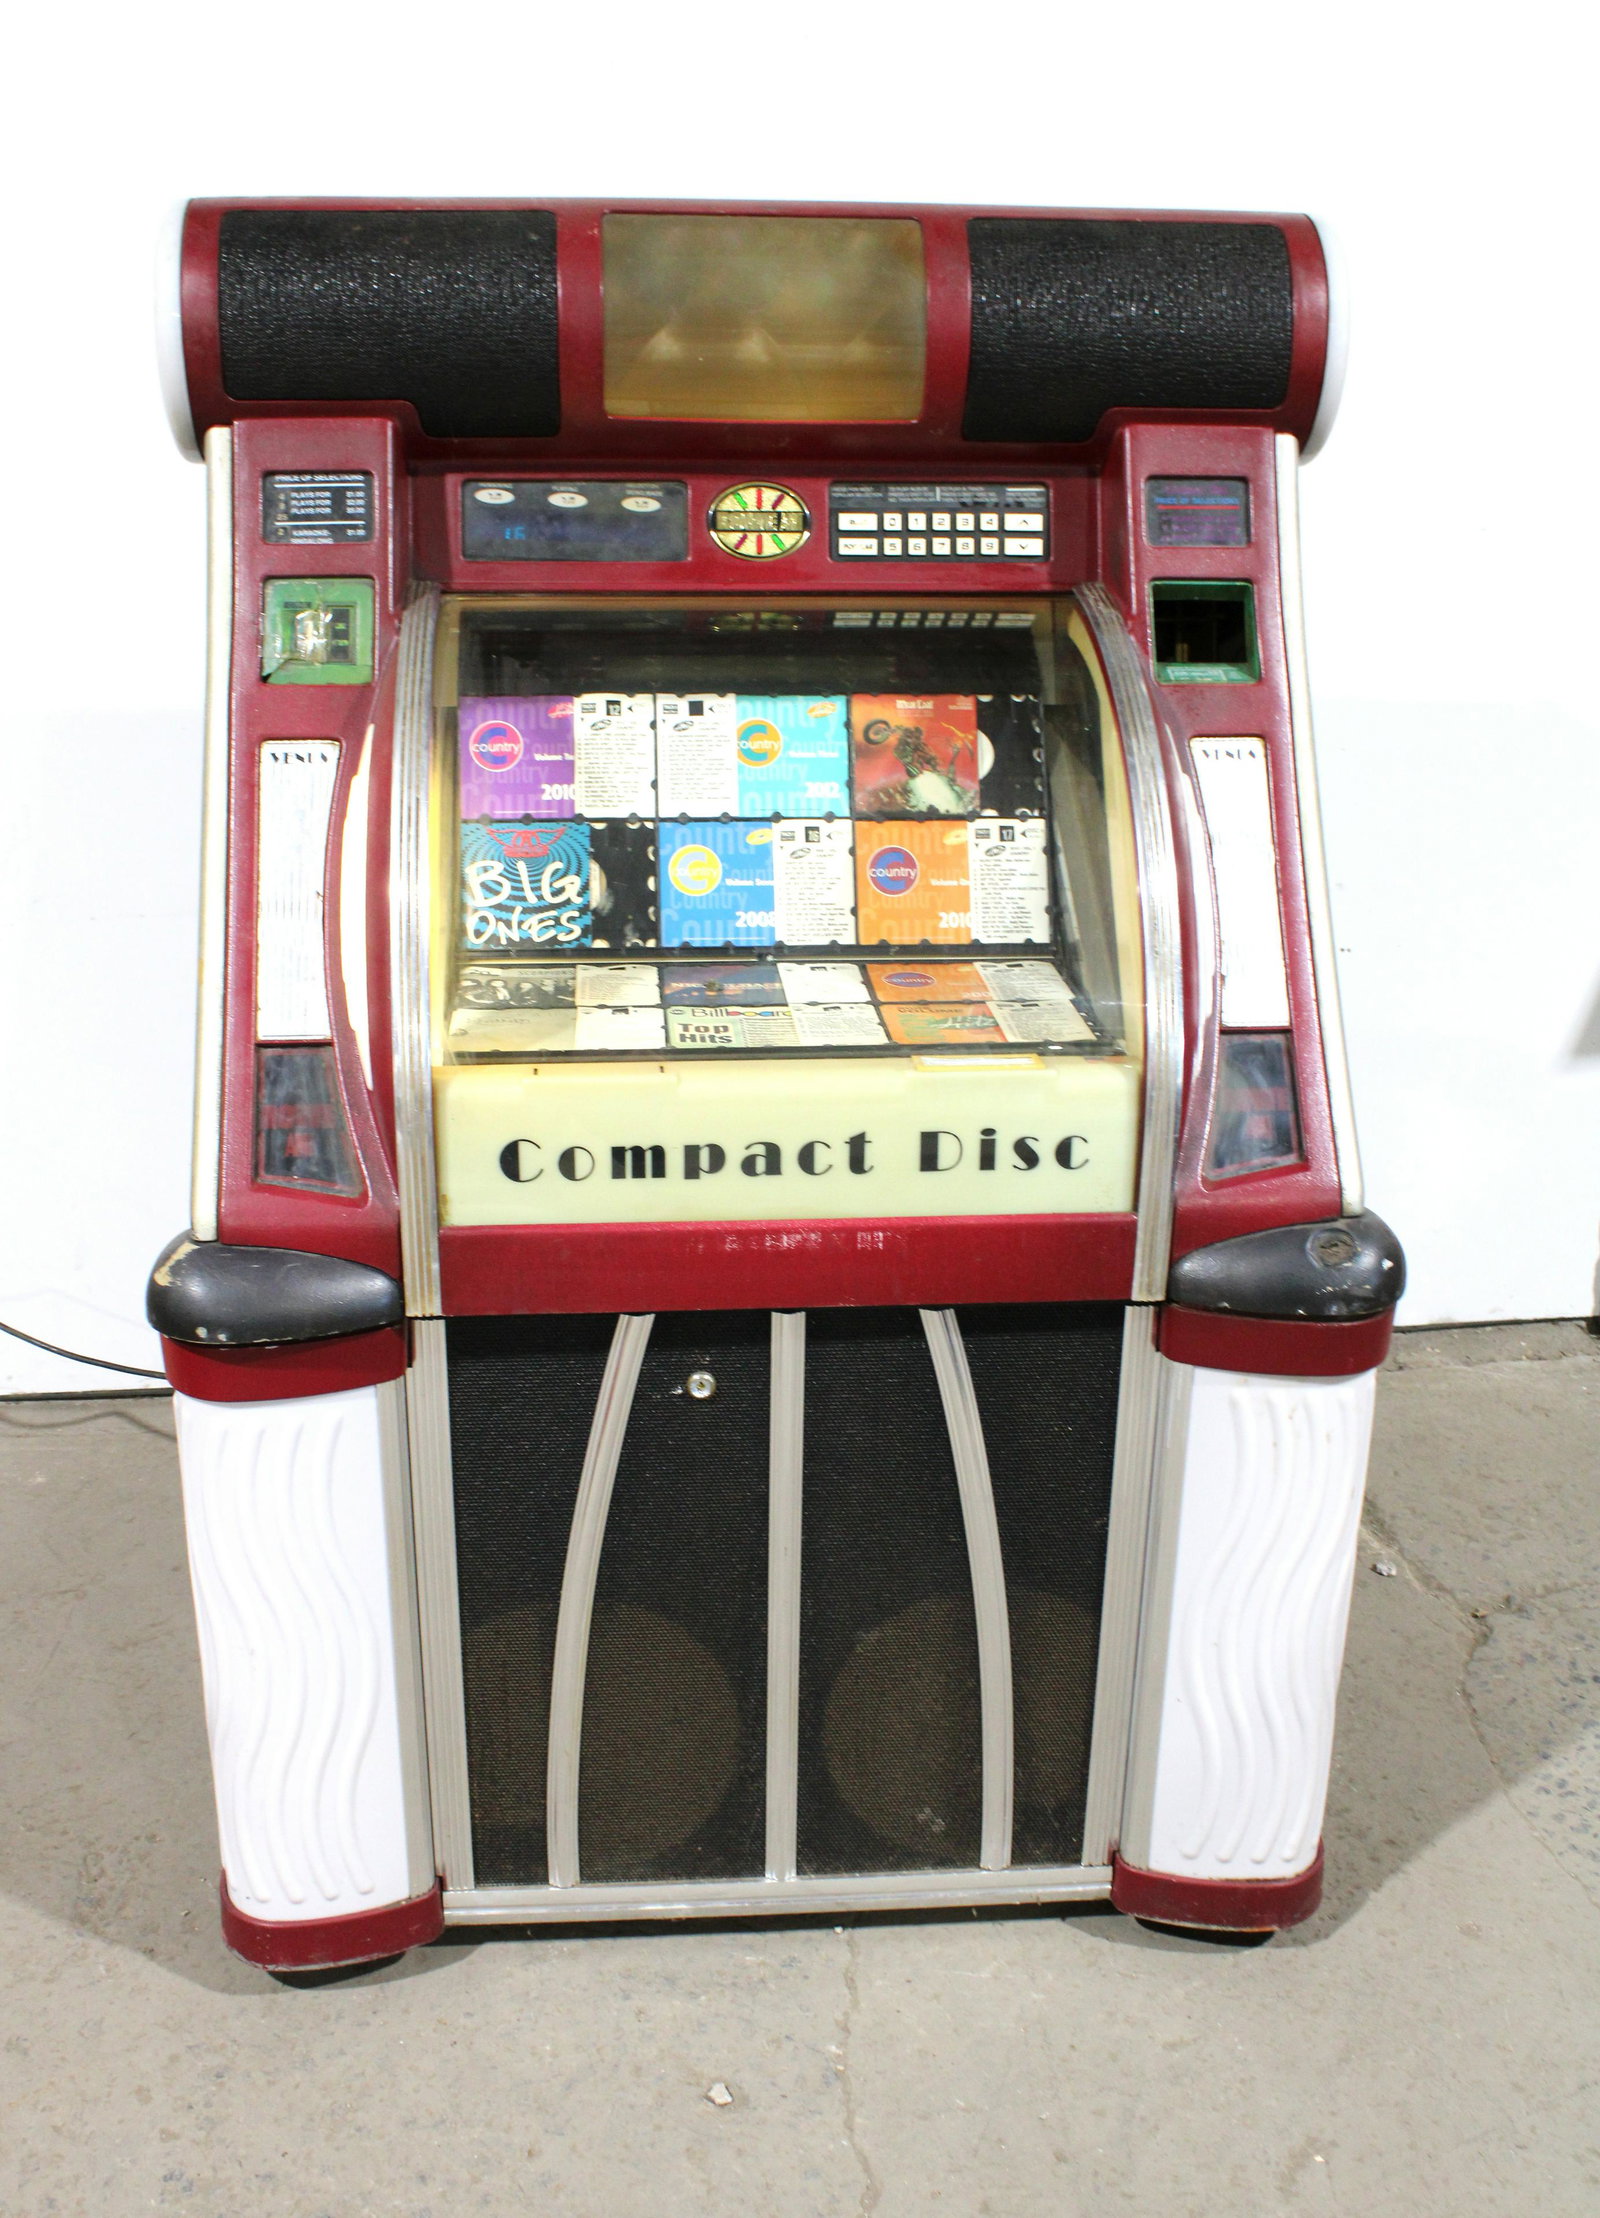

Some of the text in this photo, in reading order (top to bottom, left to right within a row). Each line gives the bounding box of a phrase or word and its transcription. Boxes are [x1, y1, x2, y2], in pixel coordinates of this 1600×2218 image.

[472, 743, 520, 755] country
[541, 784, 574, 800] 2010
[869, 867, 917, 880] country
[465, 860, 583, 907] BIG
[466, 905, 582, 945] ONES
[938, 912, 972, 929] 2010
[678, 1023, 730, 1034] Top
[680, 1033, 733, 1044] Hits
[500, 1128, 1090, 1183] Compact Disc
